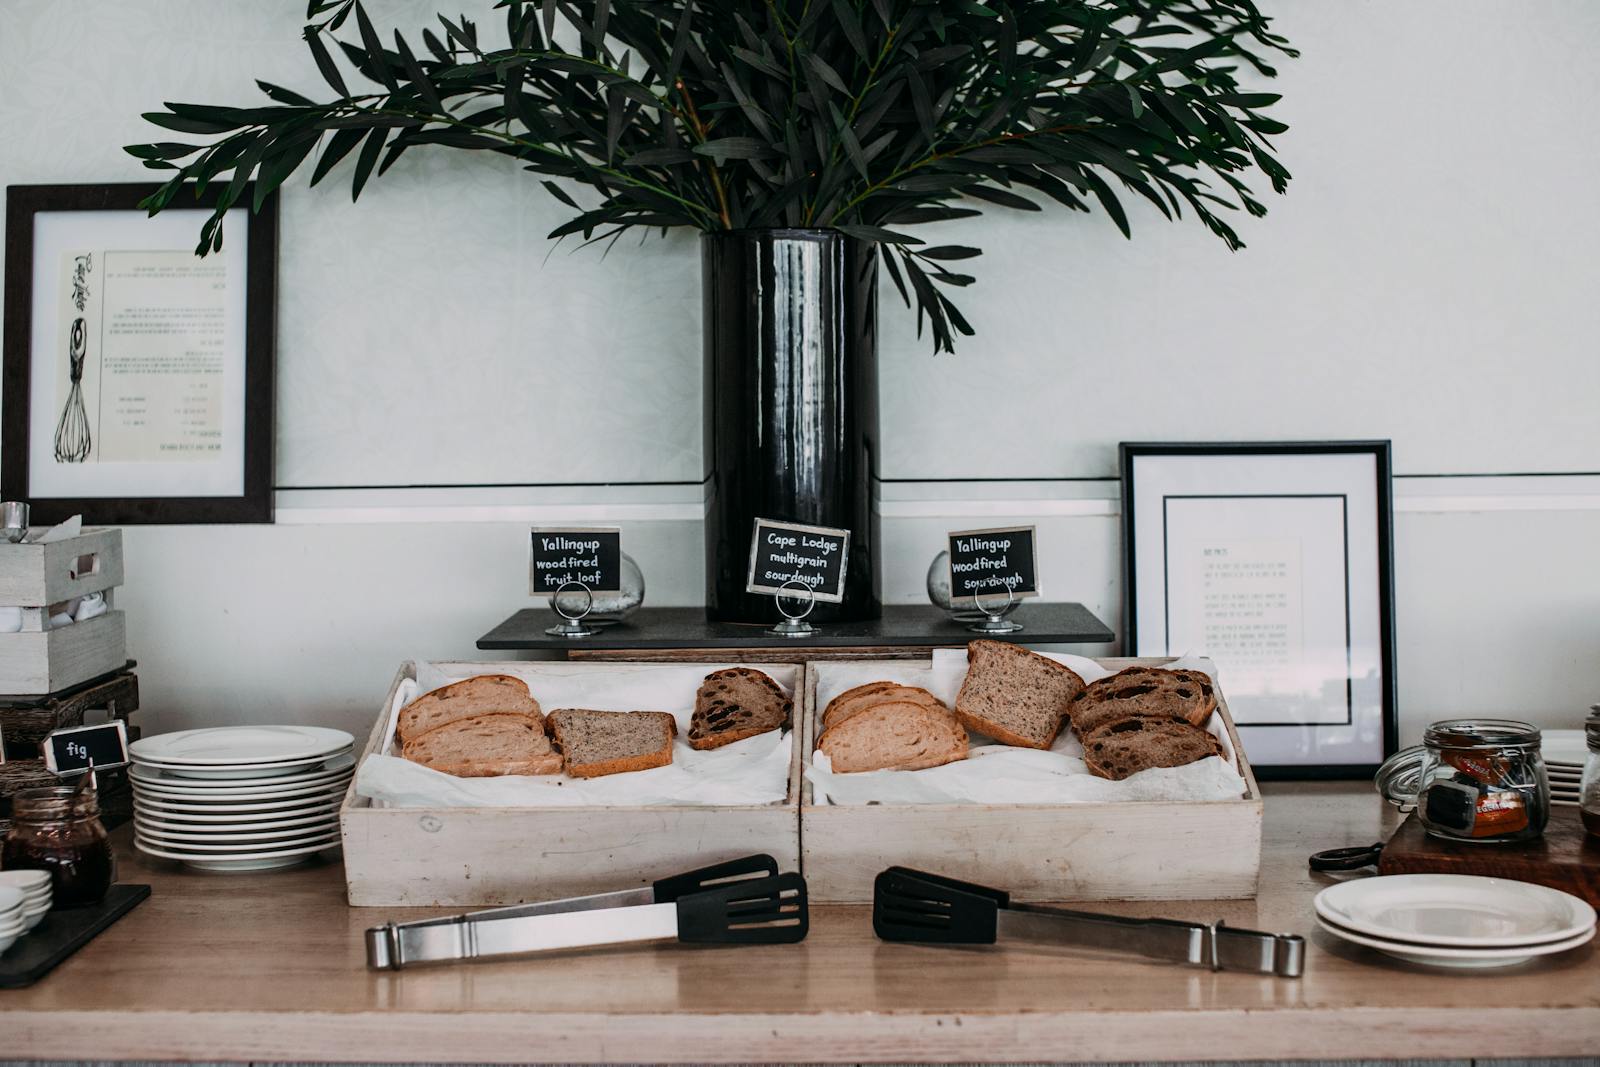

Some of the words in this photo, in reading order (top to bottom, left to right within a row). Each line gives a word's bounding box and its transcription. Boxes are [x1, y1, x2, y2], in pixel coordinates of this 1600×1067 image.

[542, 537, 600, 554] Yallingup
[767, 533, 797, 549] Cape
[802, 536, 838, 555] Lodge
[956, 537, 1011, 553] Yallingup
[770, 551, 827, 568] multigrain
[544, 572, 572, 585] fruit
[578, 570, 601, 585] loaf
[764, 570, 824, 588] sourdough
[964, 572, 1023, 589] sourdough
[66, 741, 87, 760] fig
